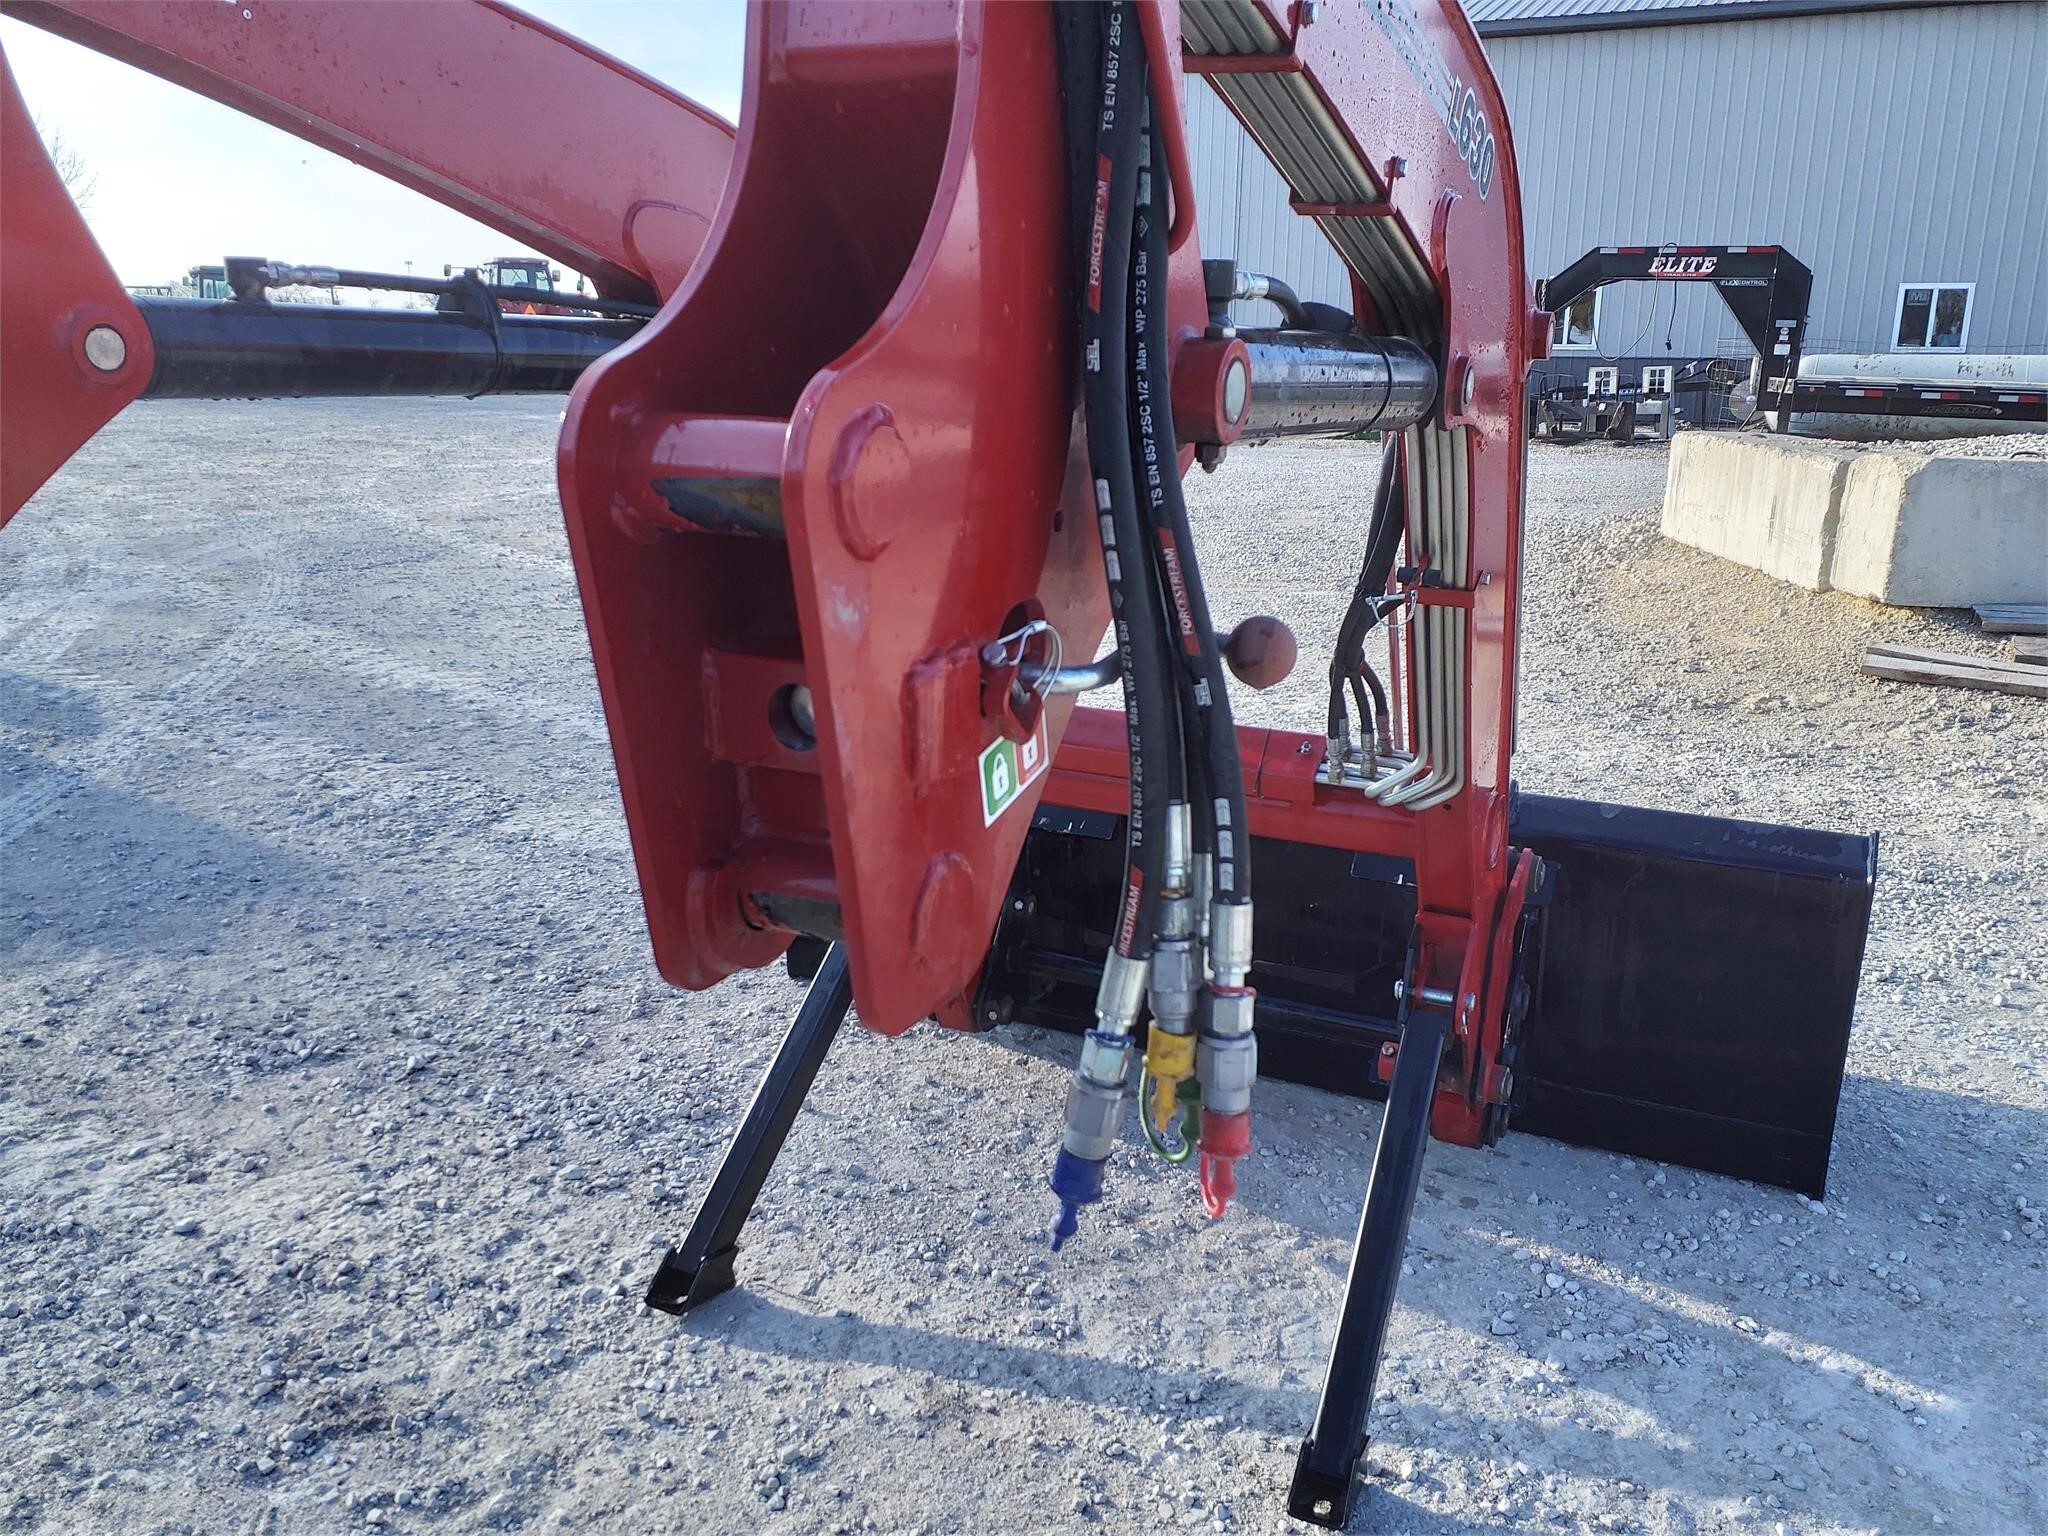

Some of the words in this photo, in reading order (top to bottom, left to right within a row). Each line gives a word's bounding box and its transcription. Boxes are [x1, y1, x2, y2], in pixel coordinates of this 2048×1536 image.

[1109, 13, 1122, 46] 2SC
[1107, 50, 1119, 79] 857
[1105, 83, 1116, 106] EN
[1102, 110, 1114, 131] TS
[1135, 249, 1147, 275] Bar
[1648, 256, 1718, 273] ELITE
[1135, 279, 1147, 306] 275
[1135, 308, 1146, 333] WP
[1139, 405, 1153, 434] 2SC
[1143, 438, 1156, 462] 857
[1147, 464, 1160, 485] EN
[1150, 488, 1163, 509] TS
[1163, 547, 1193, 636] FORCESTREAM
[1117, 619, 1129, 642] Bar
[1120, 644, 1132, 668] 275
[1123, 671, 1136, 693] WP
[1131, 756, 1143, 782] 2SC
[1132, 784, 1143, 807] 857
[1132, 809, 1143, 828] EN
[1131, 830, 1143, 848] TS
